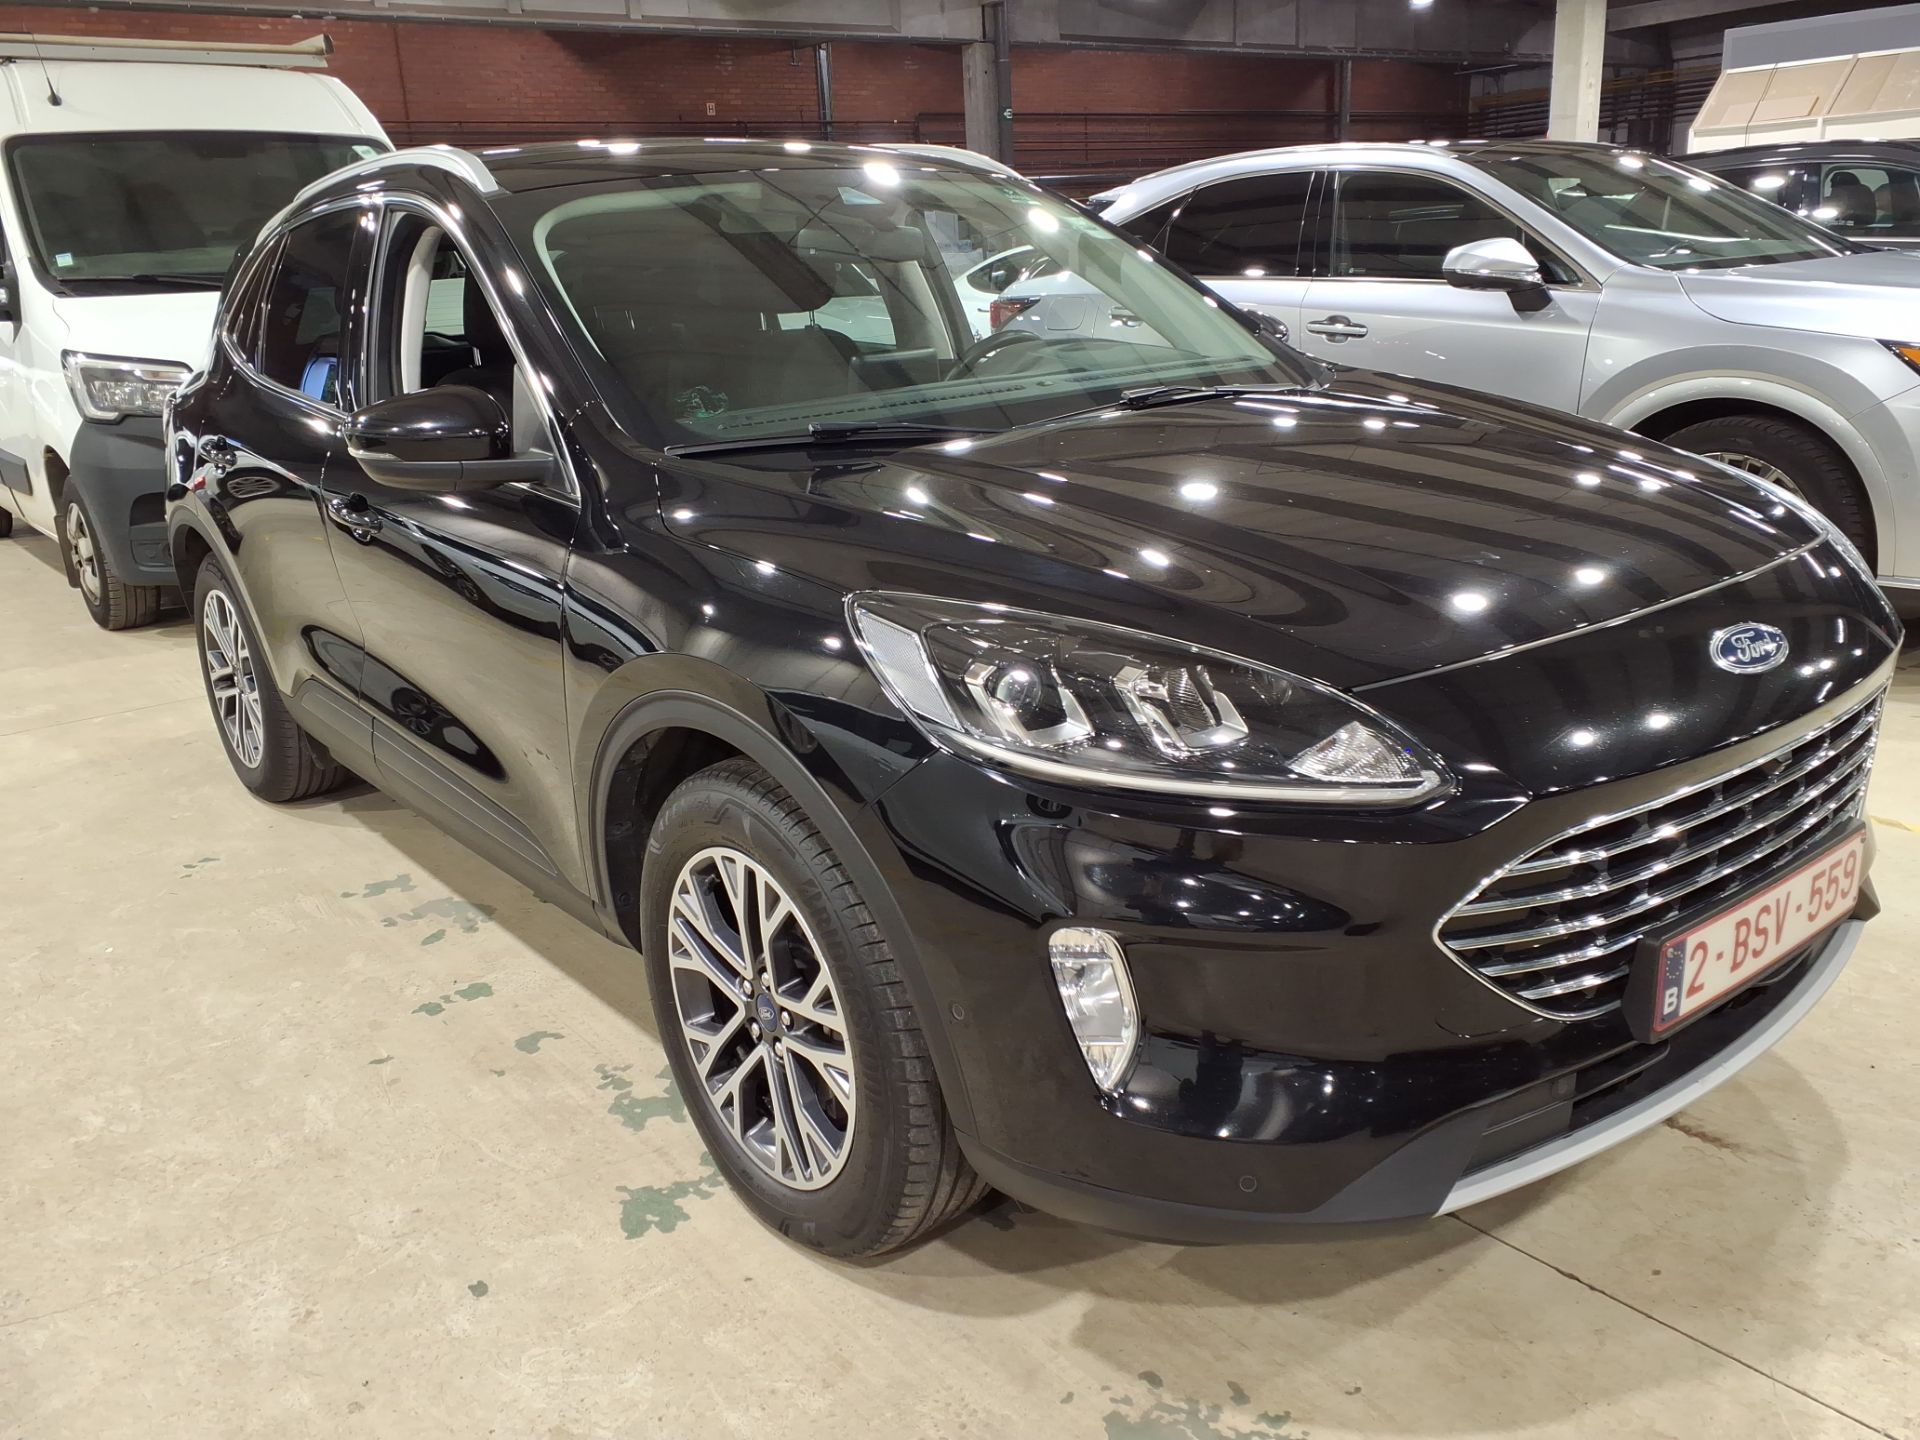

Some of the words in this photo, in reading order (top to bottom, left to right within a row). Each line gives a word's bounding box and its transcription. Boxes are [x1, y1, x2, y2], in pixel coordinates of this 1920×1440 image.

[1730, 630, 1777, 662] Ford
[1685, 849, 1858, 998] 2-BSV-559
[1663, 987, 1678, 1014] B
